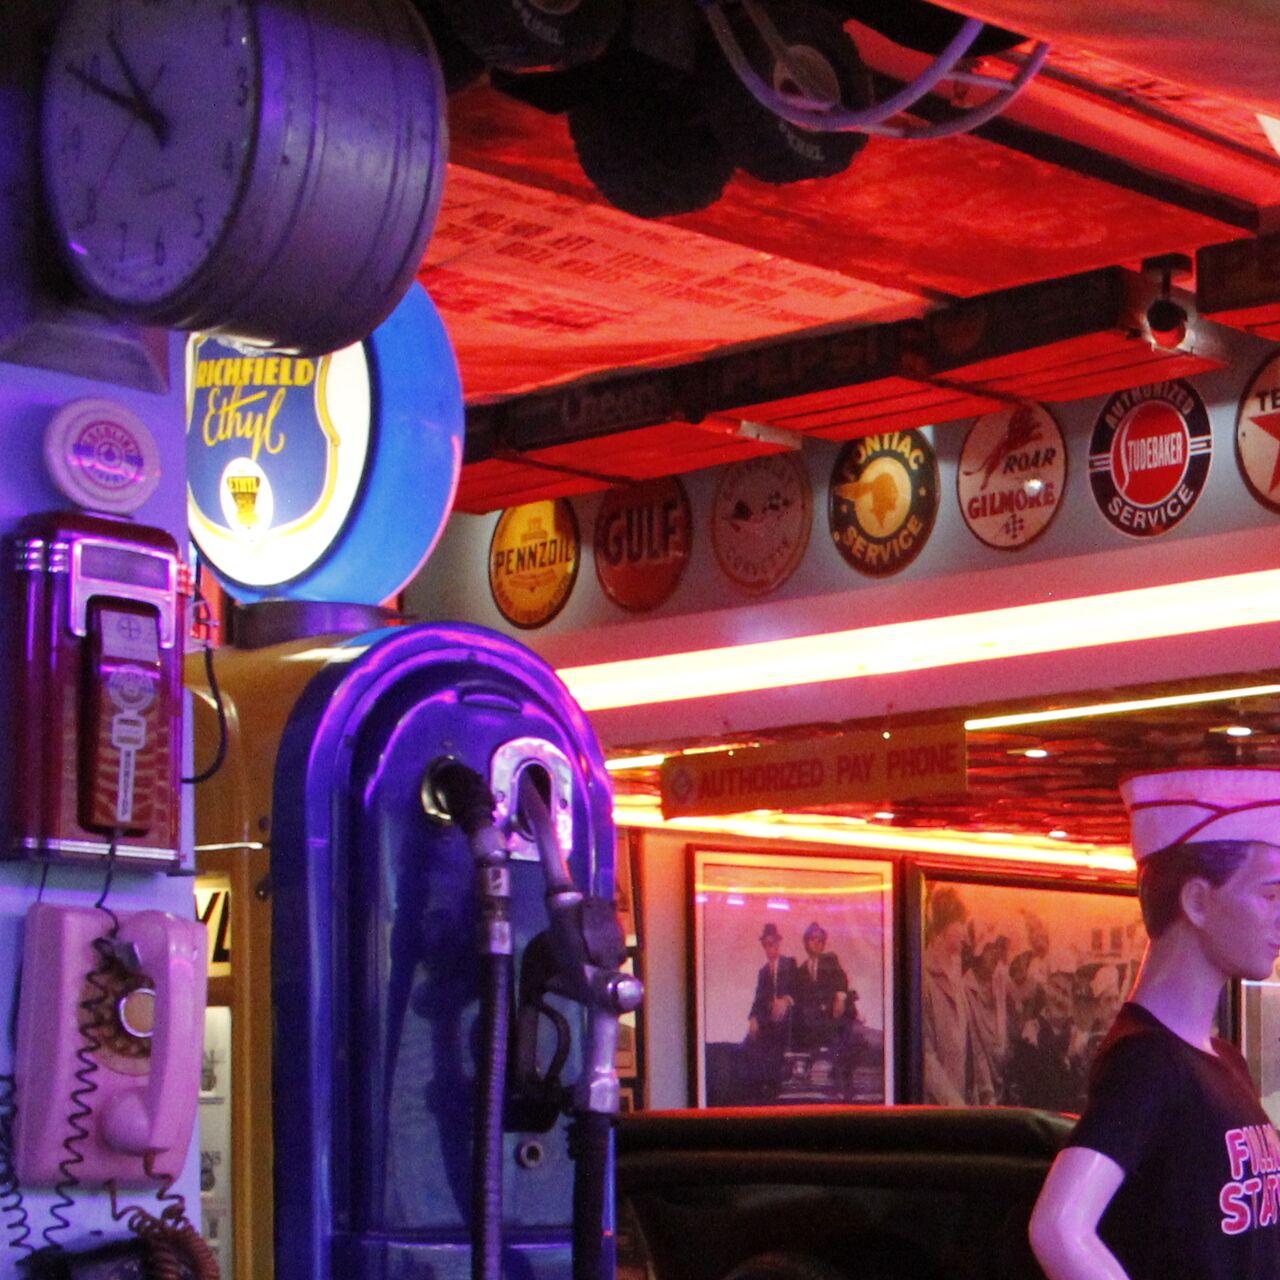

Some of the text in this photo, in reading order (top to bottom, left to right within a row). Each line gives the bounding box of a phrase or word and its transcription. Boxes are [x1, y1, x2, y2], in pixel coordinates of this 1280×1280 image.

[196, 357, 315, 388] RICHFIELD
[203, 387, 287, 462] Ethyl
[1106, 377, 1196, 429] AUTHORIZED
[856, 431, 926, 471] ONTIAC
[1003, 447, 1057, 476] ROAR
[1119, 404, 1184, 493] STUDEBAKER
[967, 484, 1056, 520] GILMORE
[1108, 483, 1193, 529] SERVICE
[492, 538, 575, 577] PENNZOIL
[607, 500, 679, 566] GULF
[845, 514, 923, 566] SERVICE
[698, 740, 958, 800] AUTHORIZED PAY PHONE
